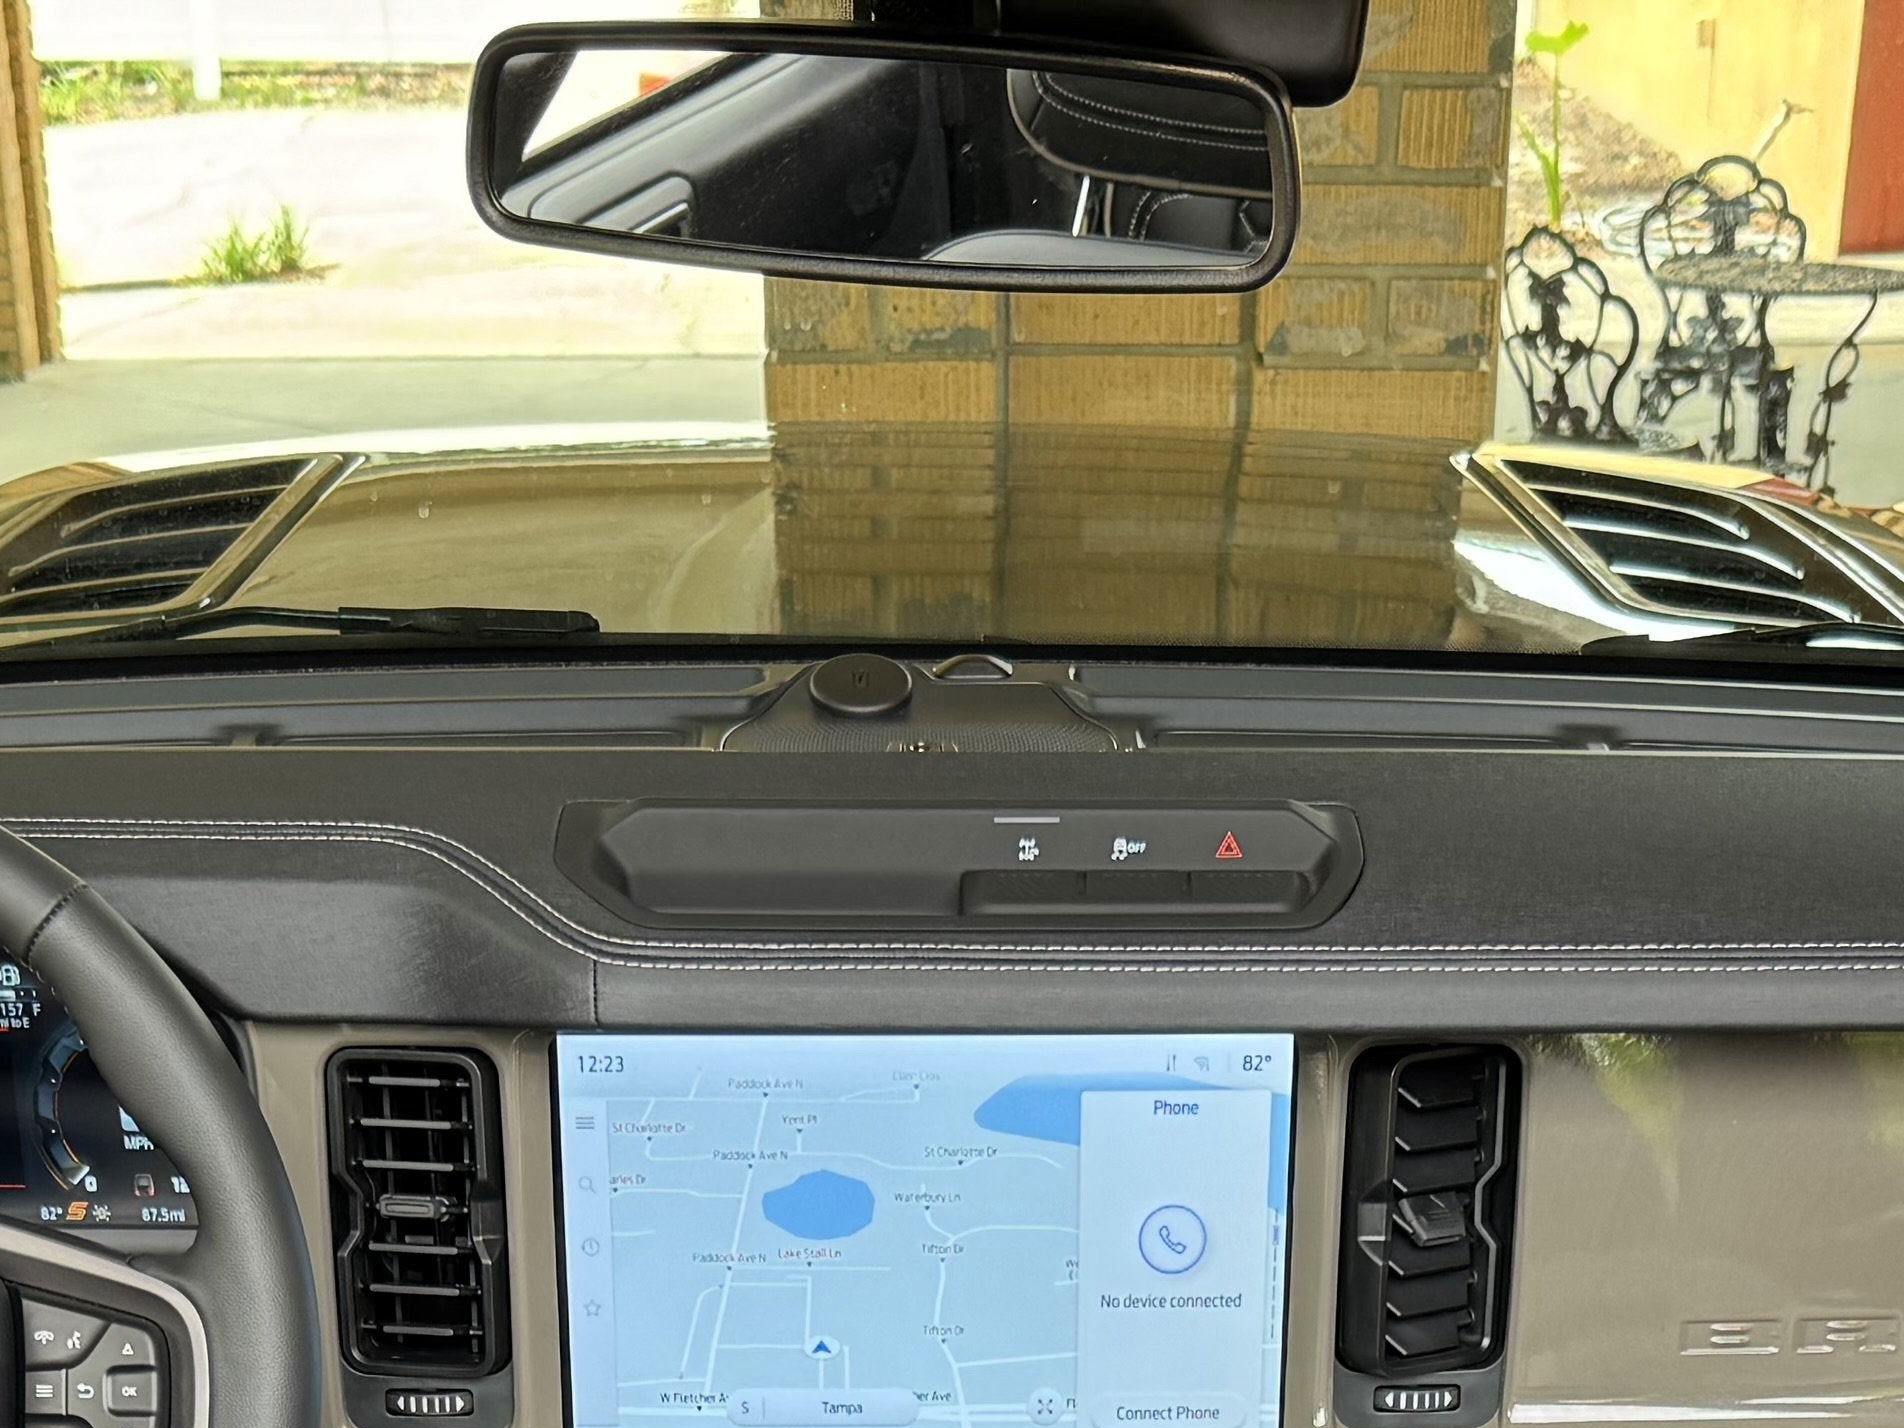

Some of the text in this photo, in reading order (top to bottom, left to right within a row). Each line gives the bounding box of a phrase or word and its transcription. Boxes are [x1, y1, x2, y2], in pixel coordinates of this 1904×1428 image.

[1127, 841, 1147, 854] OFF
[0, 1003, 23, 1016] 157
[32, 1003, 41, 1016] F
[22, 1017, 30, 1028] E
[578, 1055, 625, 1073] 12:23
[728, 1078, 772, 1090] Paddock
[774, 1078, 793, 1089] Ave
[1153, 1100, 1200, 1116] Phone
[712, 1150, 788, 1161] Paddock Ave N
[894, 1193, 946, 1203] Waterbury
[693, 1252, 734, 1263] Paddock
[737, 1252, 757, 1263] Ave
[778, 1248, 802, 1259] Lake
[1100, 1294, 1242, 1308] No device connected
[121, 1385, 138, 1397] OK
[932, 1391, 952, 1402] Ave
[660, 1392, 670, 1403] W
[741, 1402, 750, 1414] S
[822, 1402, 863, 1416] Tampa
[1116, 1406, 1220, 1421] Connect Phone
